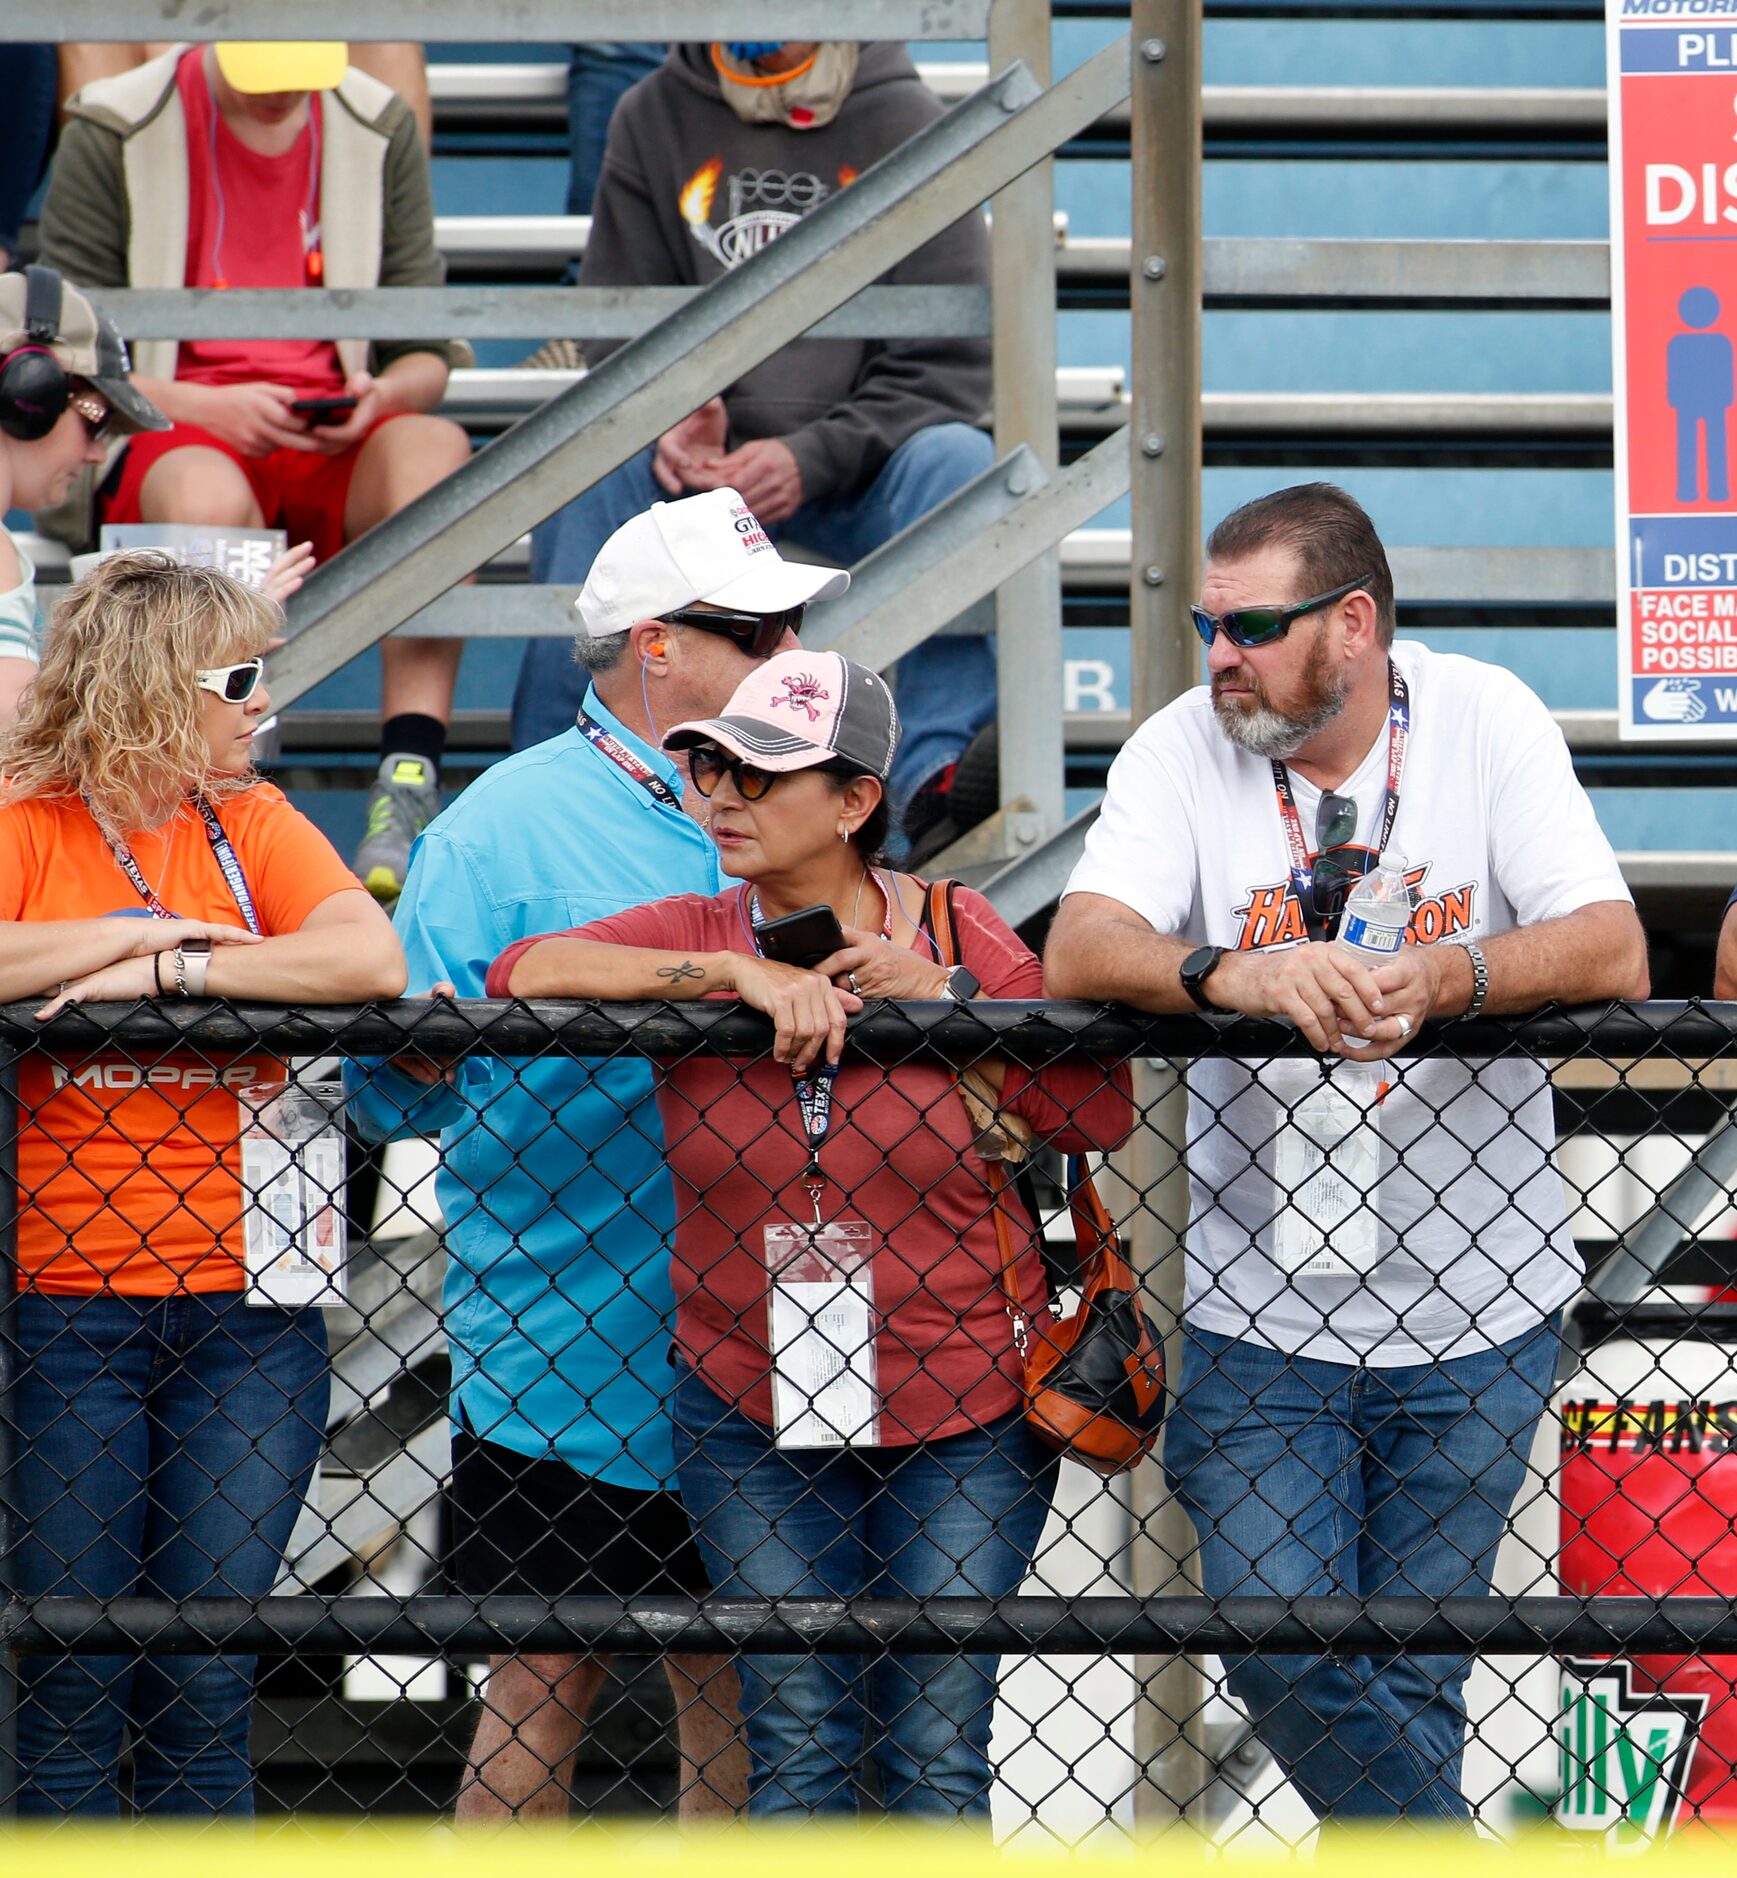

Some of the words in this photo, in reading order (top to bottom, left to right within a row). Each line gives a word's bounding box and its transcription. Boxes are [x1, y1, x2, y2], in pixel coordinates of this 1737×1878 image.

[1641, 594, 1708, 618] FACE
[648, 780, 666, 795] NO
[127, 858, 149, 894] TEXAS
[51, 1064, 257, 1090] MOPAR
